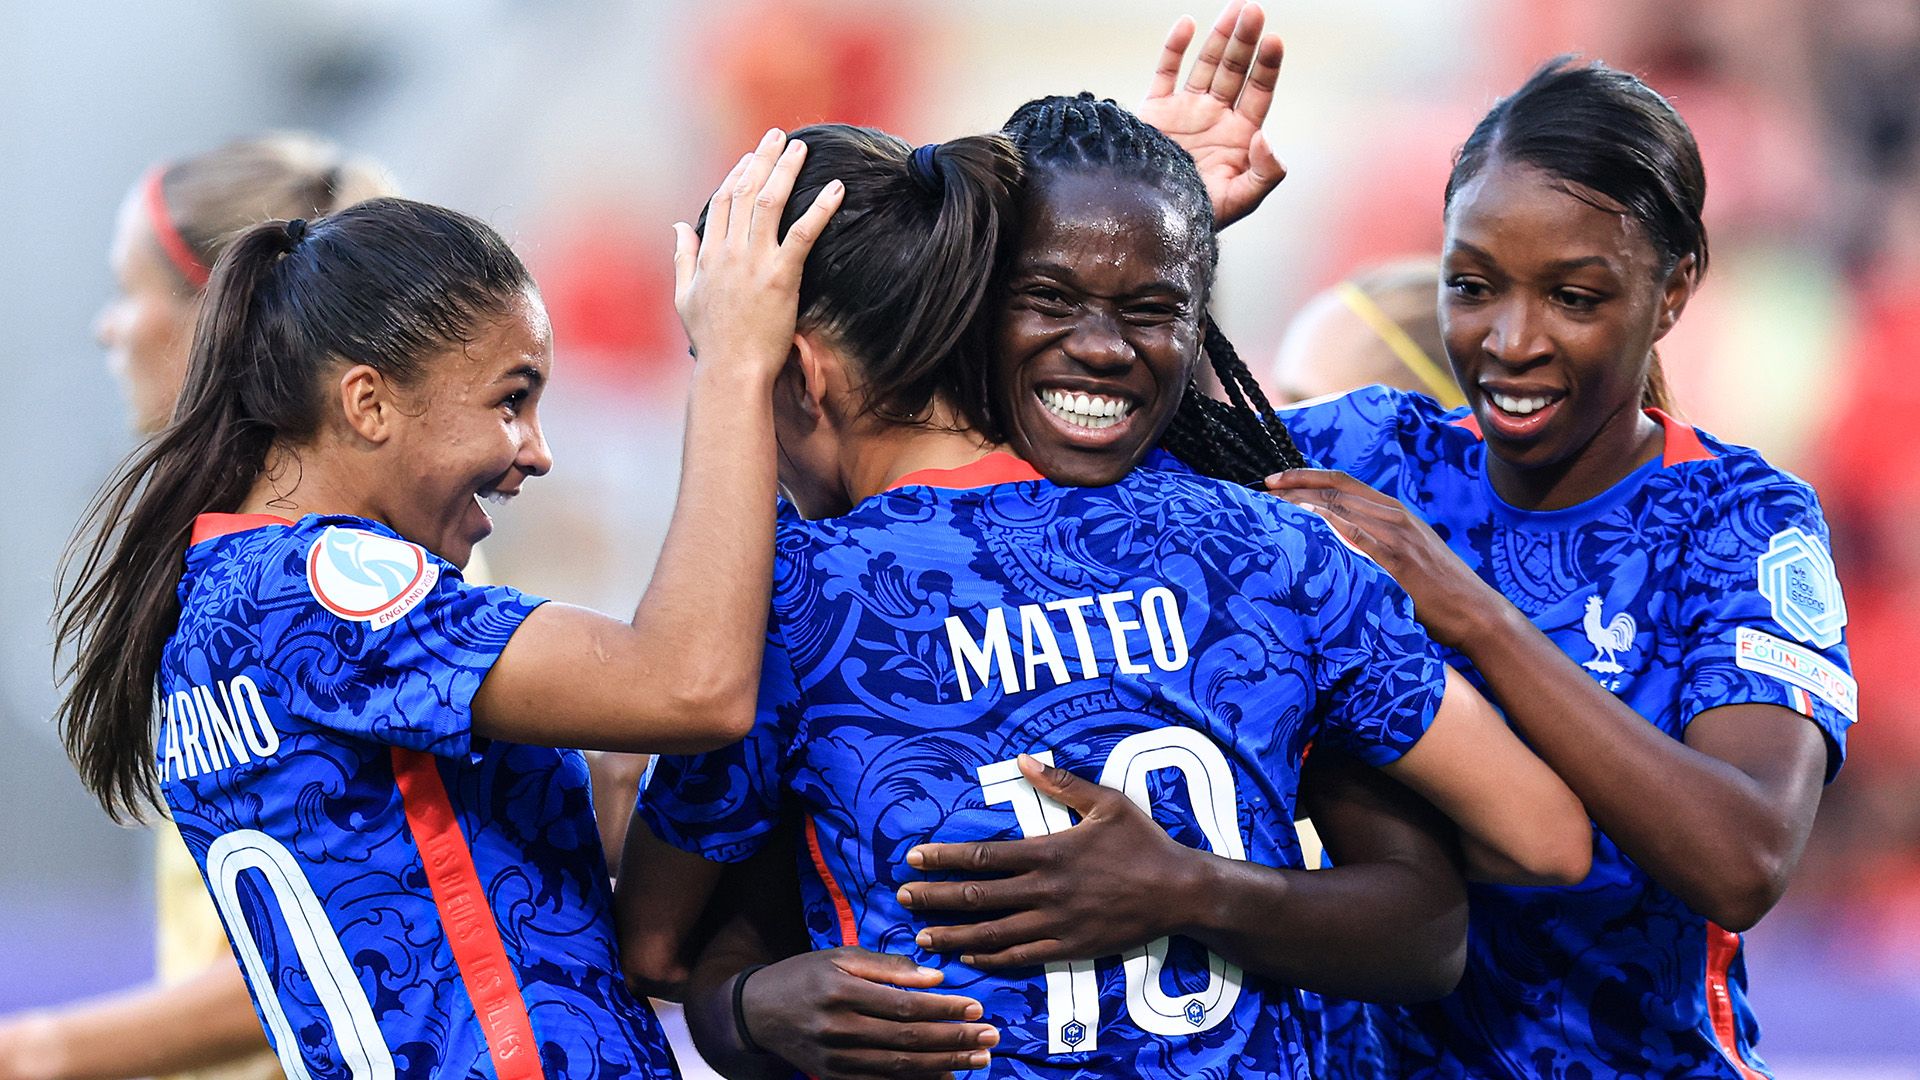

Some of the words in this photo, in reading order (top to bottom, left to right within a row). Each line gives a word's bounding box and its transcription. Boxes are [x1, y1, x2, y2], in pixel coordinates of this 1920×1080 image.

[379, 588, 424, 624] ENGLAND
[421, 569, 436, 589] 2022
[1741, 632, 1772, 645] UEFA
[944, 586, 1189, 701] MATEO
[1741, 641, 1854, 704] FOUNDATION
[157, 674, 280, 784] ARINO
[976, 726, 1246, 1054] 10
